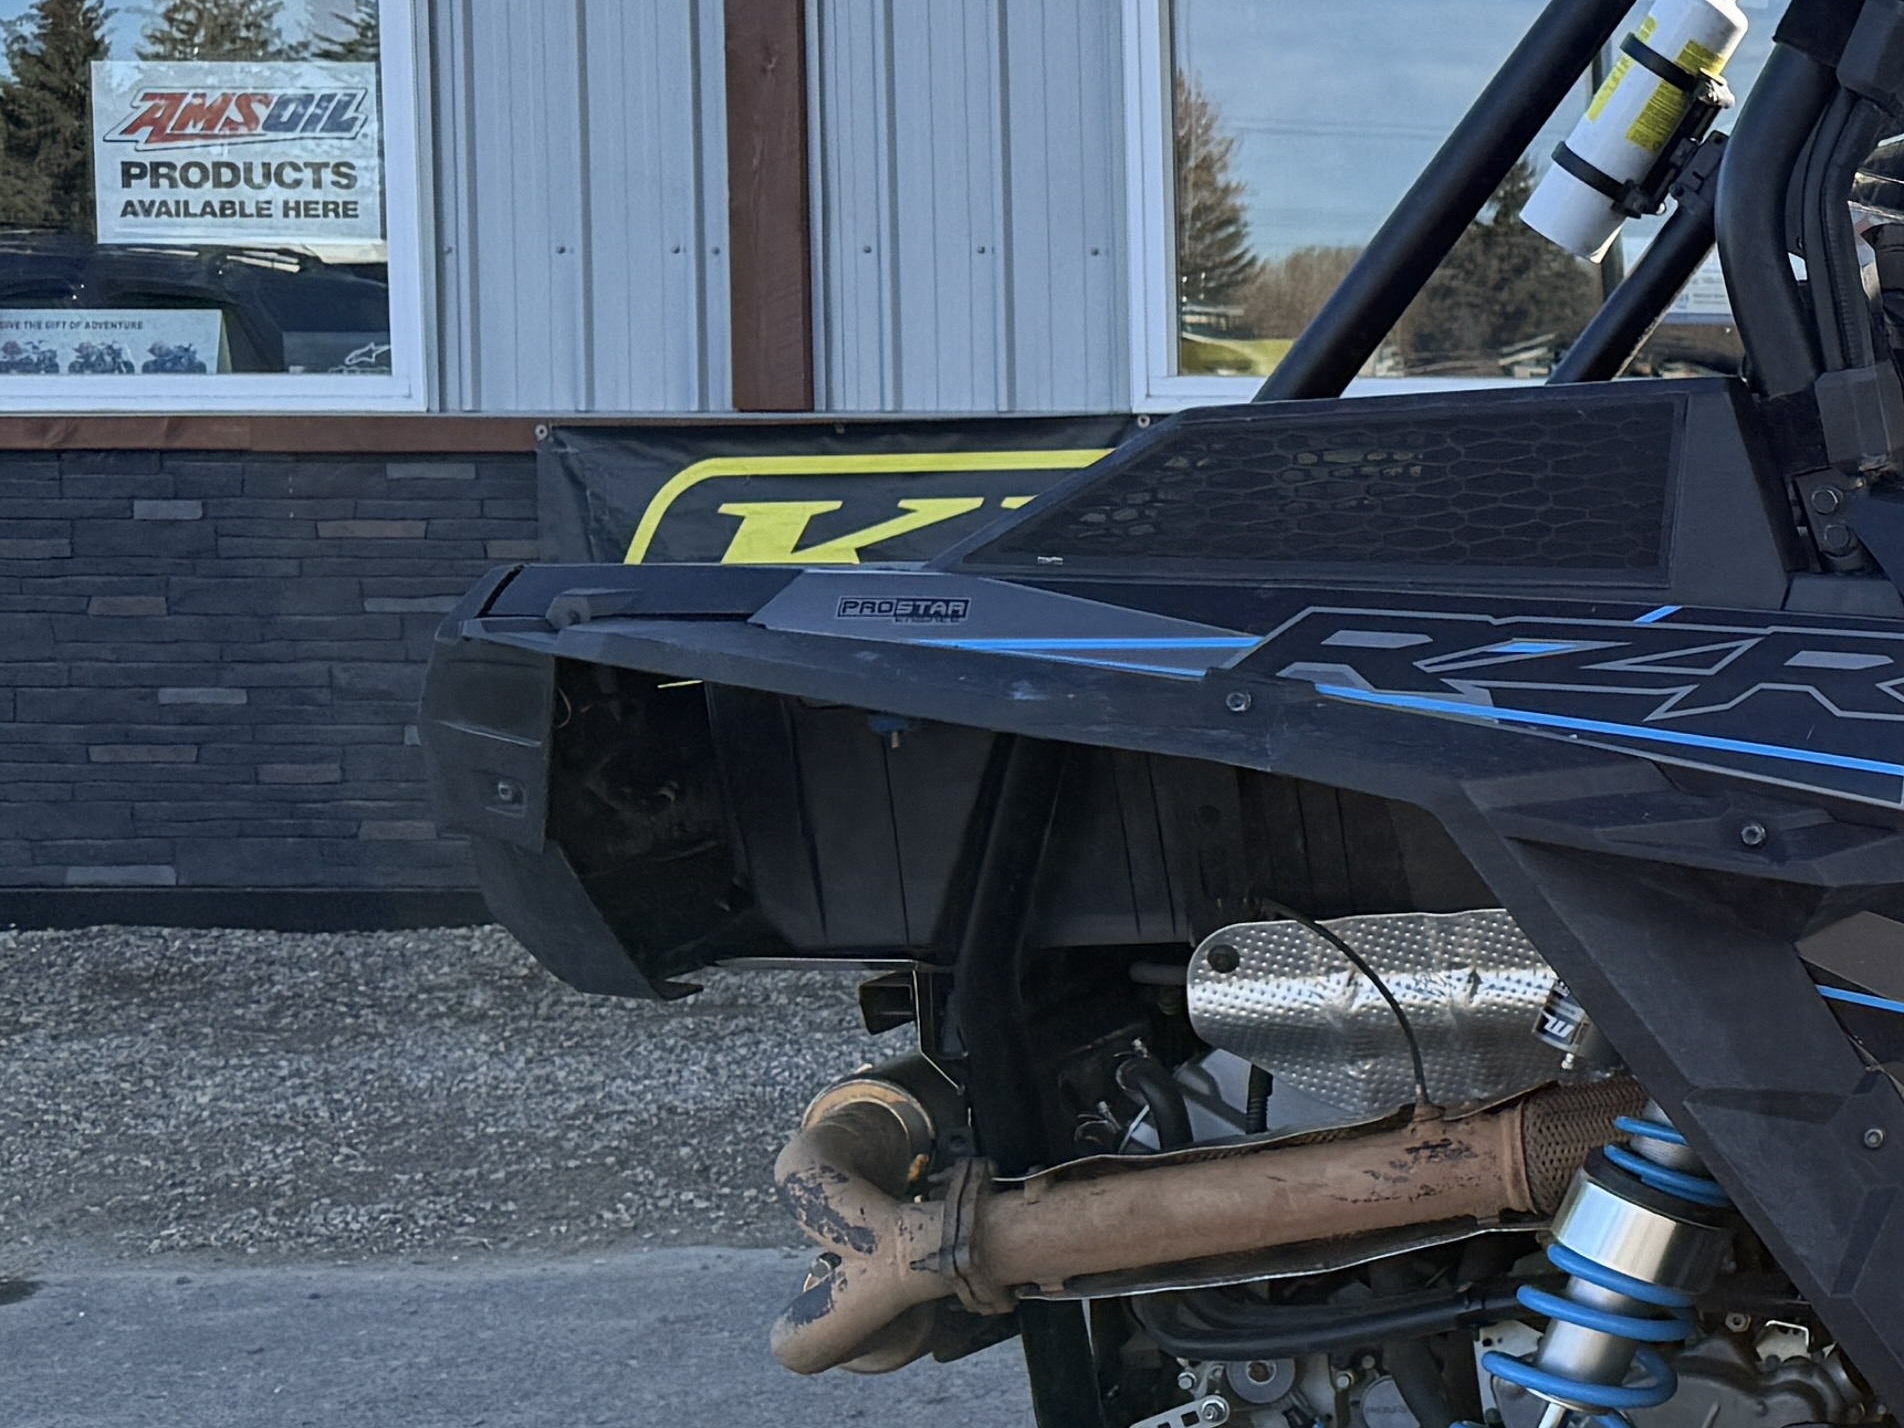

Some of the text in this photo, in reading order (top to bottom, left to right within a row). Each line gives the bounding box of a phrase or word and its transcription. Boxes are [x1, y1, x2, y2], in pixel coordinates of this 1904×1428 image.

[120, 90, 367, 143] AMSOIL
[120, 160, 357, 190] PRODUCTS
[120, 199, 359, 219] AVAILABLE HERE
[841, 600, 967, 615] PROSTAR
